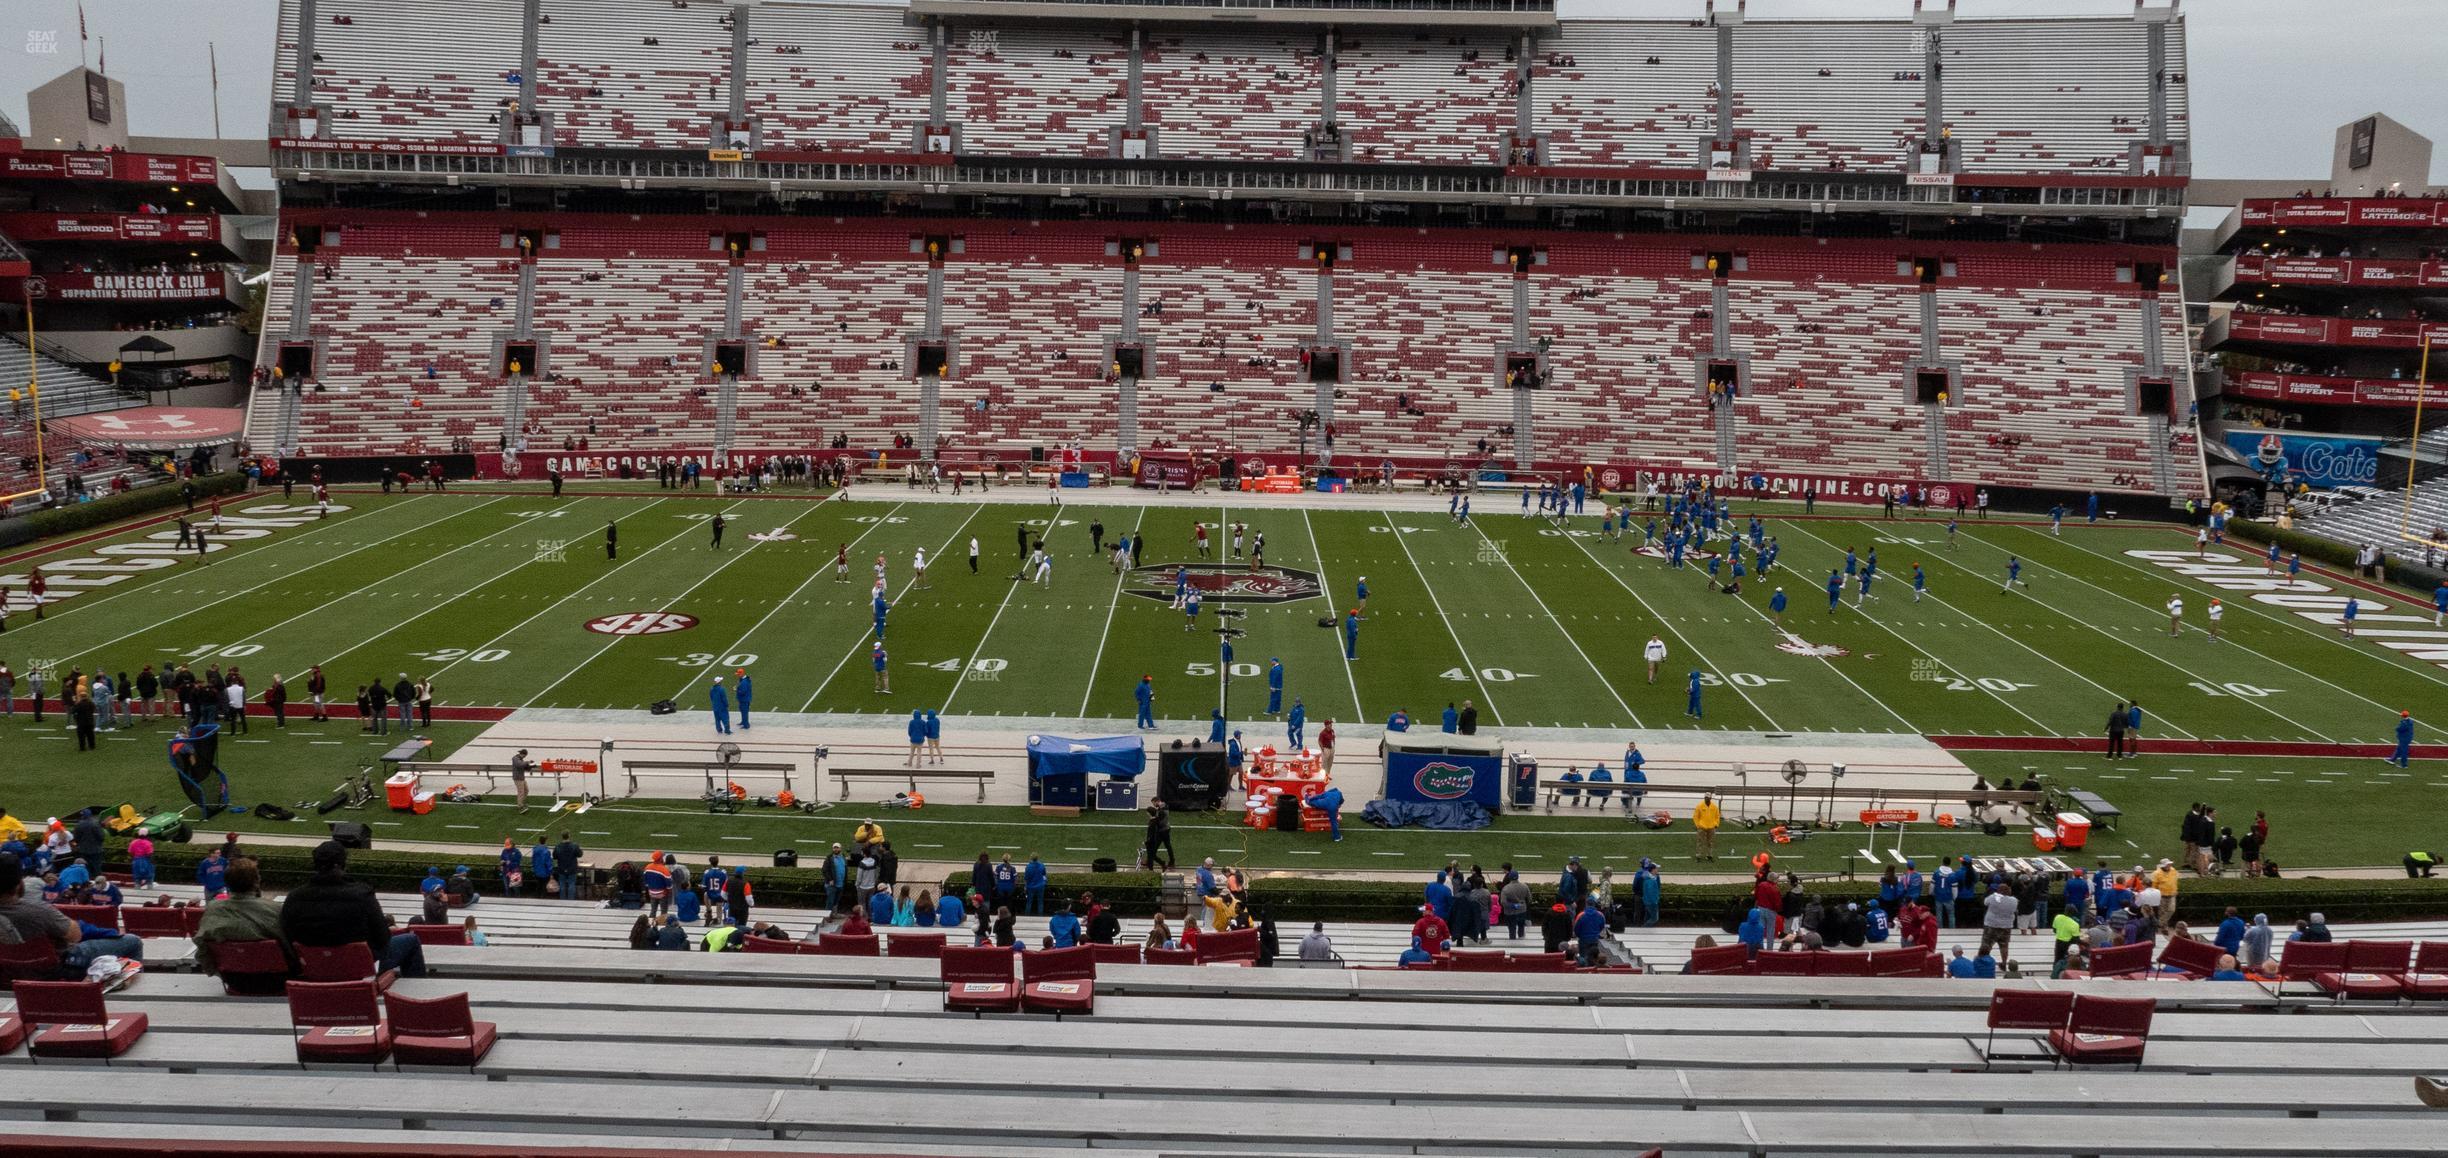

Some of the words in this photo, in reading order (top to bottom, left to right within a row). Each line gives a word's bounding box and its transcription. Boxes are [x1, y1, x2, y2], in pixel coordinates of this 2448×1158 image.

[57, 225, 114, 233] NORWOOD
[94, 275, 174, 289] GAMECOCK
[179, 275, 206, 288] CLUB
[61, 289, 118, 298] SUPPORTING
[121, 289, 158, 298] STUDENT
[160, 288, 193, 297] ATHLETES
[194, 288, 209, 297] SINCE
[2289, 388, 2334, 396] JEFFERY
[422, 648, 512, 662] 20
[677, 652, 759, 667] 30
[930, 658, 1009, 672] 40
[1185, 662, 1262, 677] 50
[1439, 667, 1517, 682] 40
[1934, 677, 2019, 692] 20
[2188, 681, 2268, 697] 10
[552, 763, 584, 771] GATORADE
[1520, 767, 1533, 780] F
[999, 870, 1011, 881] 86
[708, 877, 721, 890] 15
[2102, 878, 2113, 889] 15
[1876, 917, 1888, 930] 21
